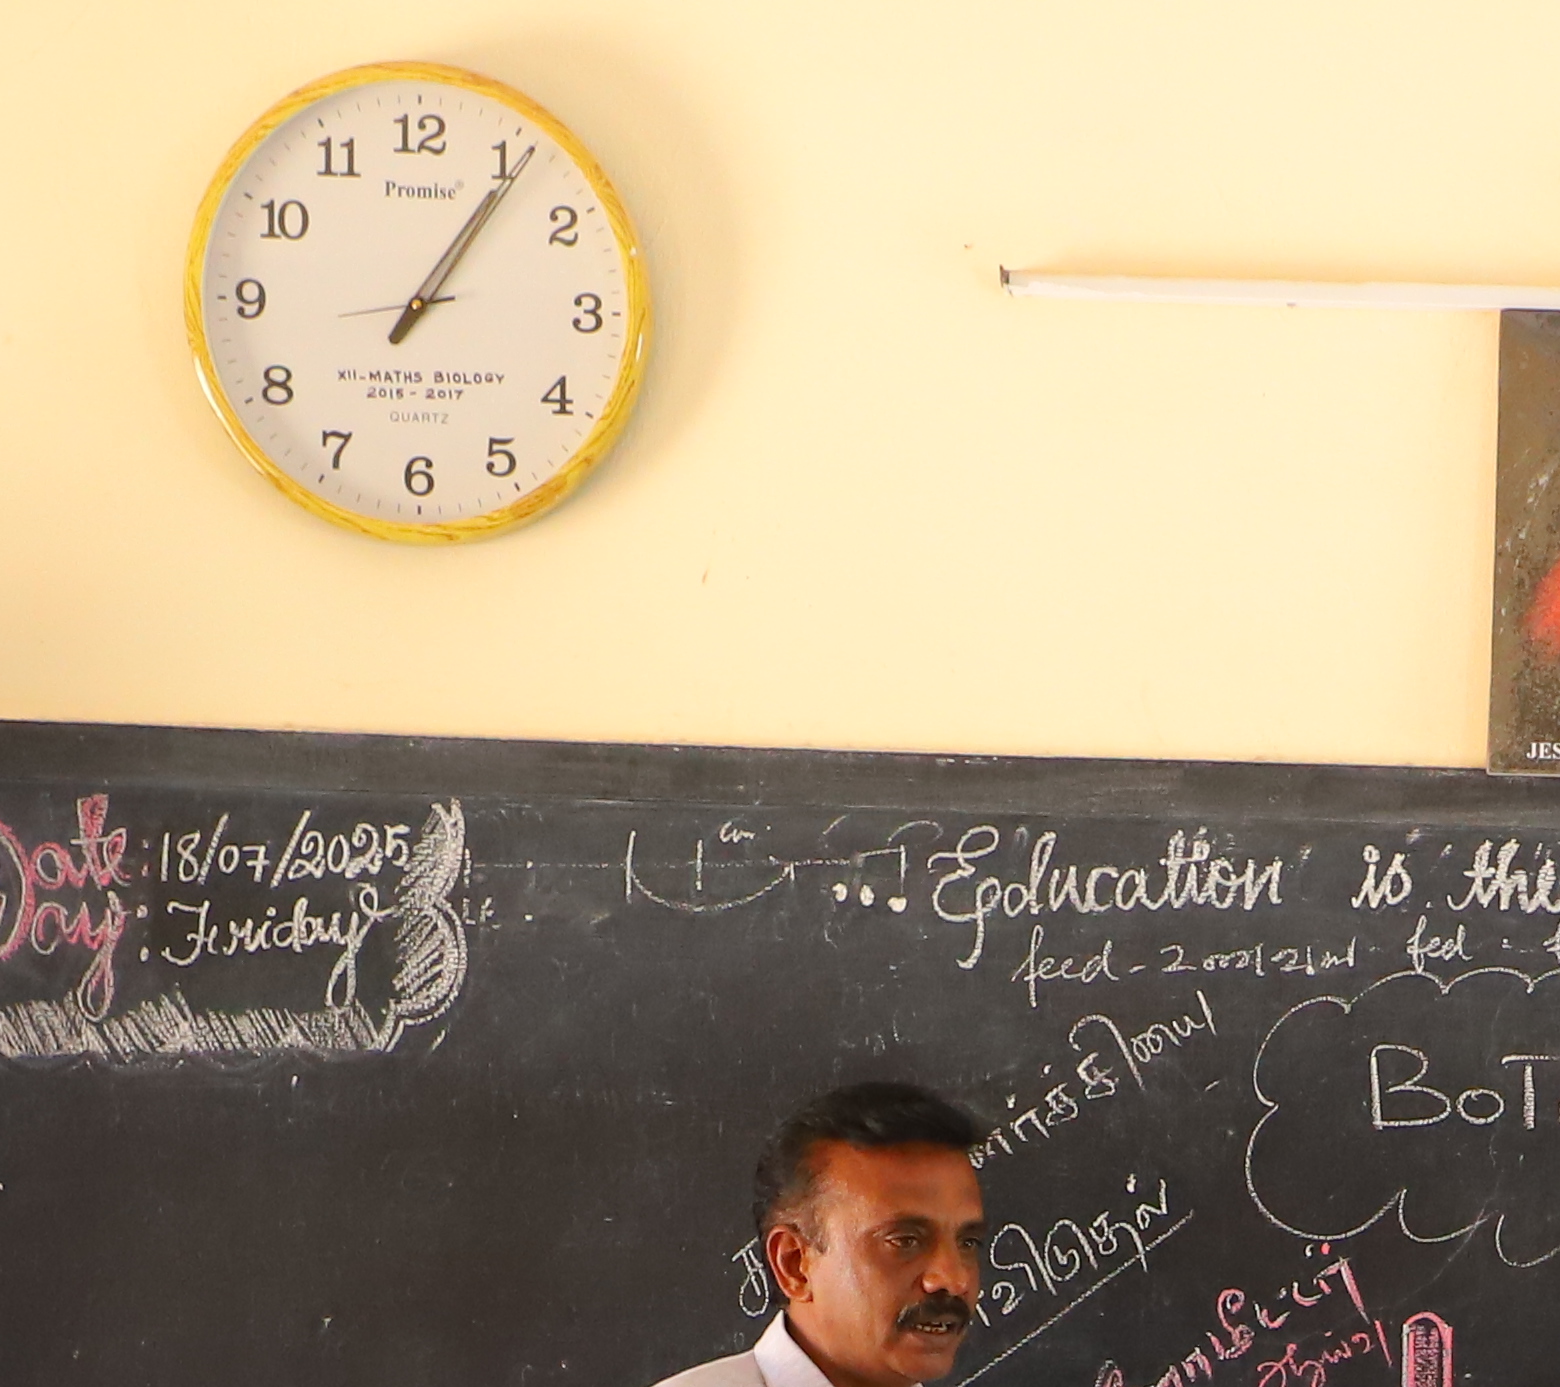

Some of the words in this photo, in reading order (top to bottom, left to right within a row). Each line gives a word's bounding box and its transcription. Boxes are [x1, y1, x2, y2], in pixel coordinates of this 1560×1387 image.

[393, 113, 447, 155] 12
[317, 136, 360, 178] 11
[491, 141, 515, 180] 1
[384, 180, 457, 200] Promise
[260, 199, 309, 239] 10
[548, 206, 578, 246] 2
[235, 279, 267, 319] 9
[571, 293, 603, 334] 3
[261, 365, 294, 405] 8
[426, 388, 463, 400] 2017
[434, 371, 504, 385] BIOLOGY
[541, 376, 574, 415] 4
[389, 412, 449, 425] QUARTZ
[321, 430, 353, 470] 7
[486, 437, 517, 477] 5
[404, 457, 435, 496] 6
